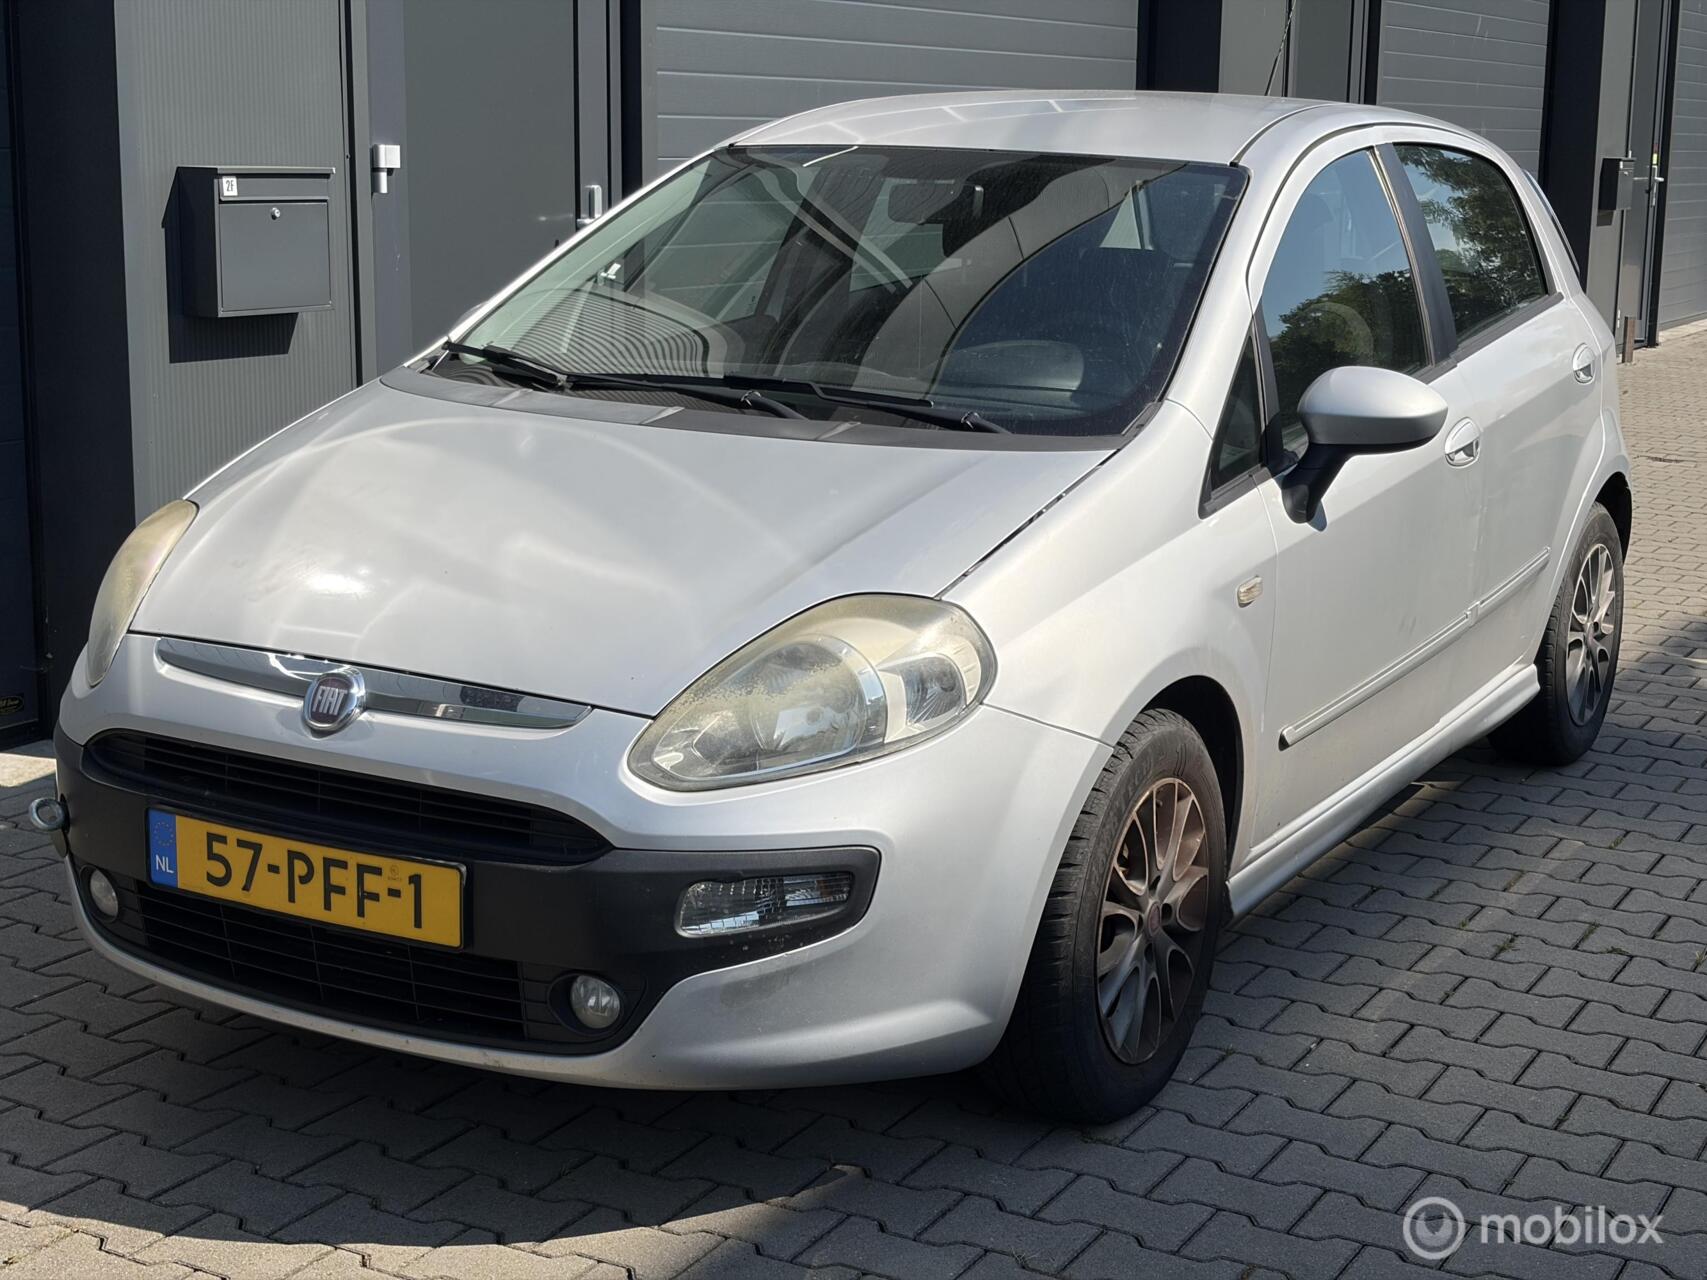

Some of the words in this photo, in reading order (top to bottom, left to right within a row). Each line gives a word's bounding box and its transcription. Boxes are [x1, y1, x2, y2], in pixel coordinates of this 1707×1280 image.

[225, 179, 235, 192] 2F
[312, 685, 348, 716] FIAT
[155, 854, 175, 875] NL
[206, 831, 422, 930] 57-PFF-1
